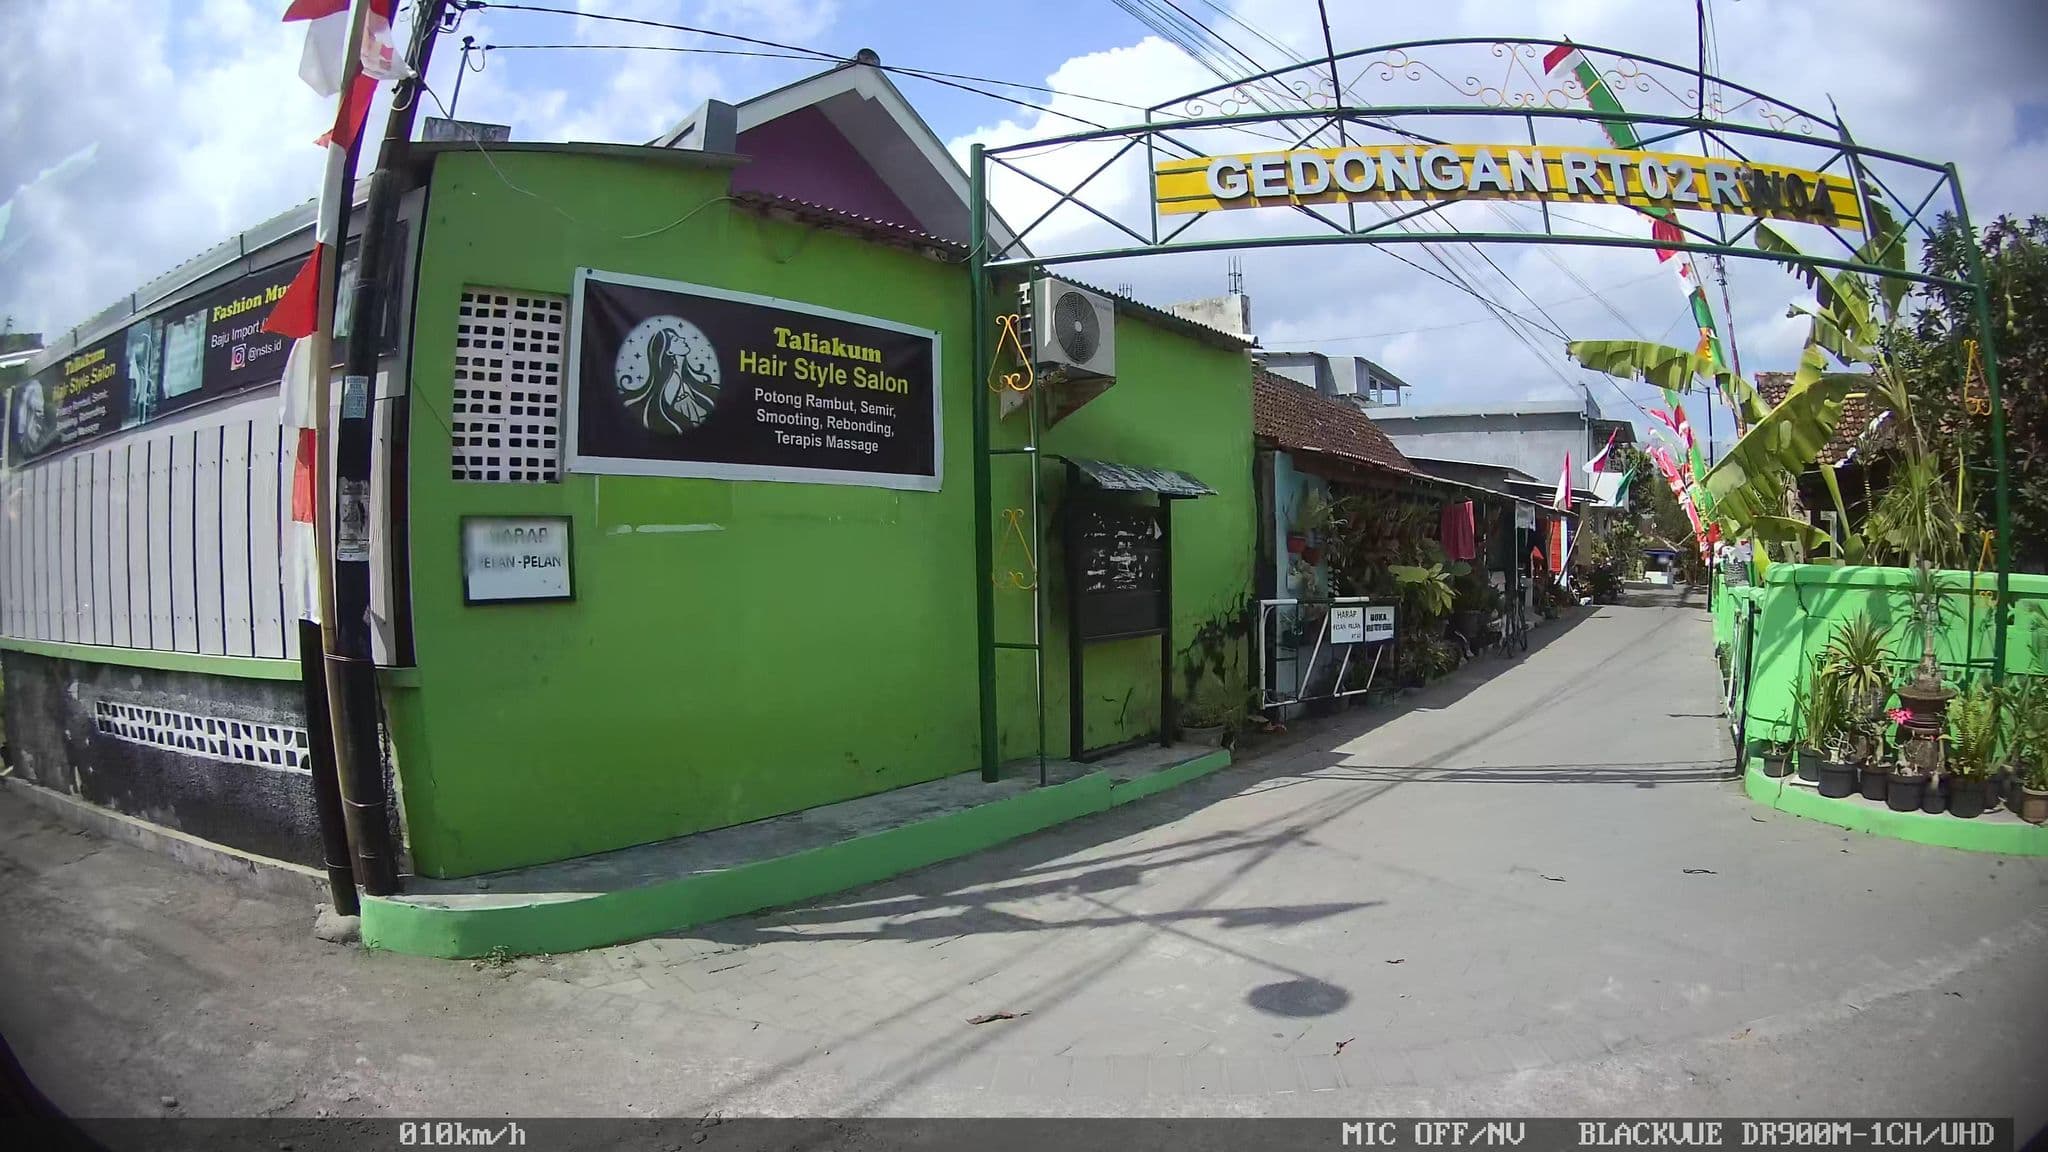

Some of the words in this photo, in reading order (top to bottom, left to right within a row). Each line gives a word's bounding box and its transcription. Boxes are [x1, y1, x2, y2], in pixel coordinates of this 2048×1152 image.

[1206, 149, 1547, 199] GEDONGAN
[1561, 152, 1628, 197] RT
[1639, 159, 1699, 203] 02
[212, 295, 262, 323] Fashion
[264, 284, 292, 304] Mu
[211, 331, 230, 348] Baju
[231, 320, 260, 341] Import
[773, 326, 882, 363] Taliakum
[739, 350, 787, 377] Hair
[794, 357, 848, 388] Style
[853, 366, 909, 394] Salon
[754, 387, 802, 409] Potong
[805, 393, 857, 414] Rambut,
[860, 400, 897, 419] Semir,
[756, 408, 823, 430] Smooting,
[826, 415, 895, 438] Rebonding,
[774, 430, 823, 449] Terapis
[825, 434, 879, 454] Massage
